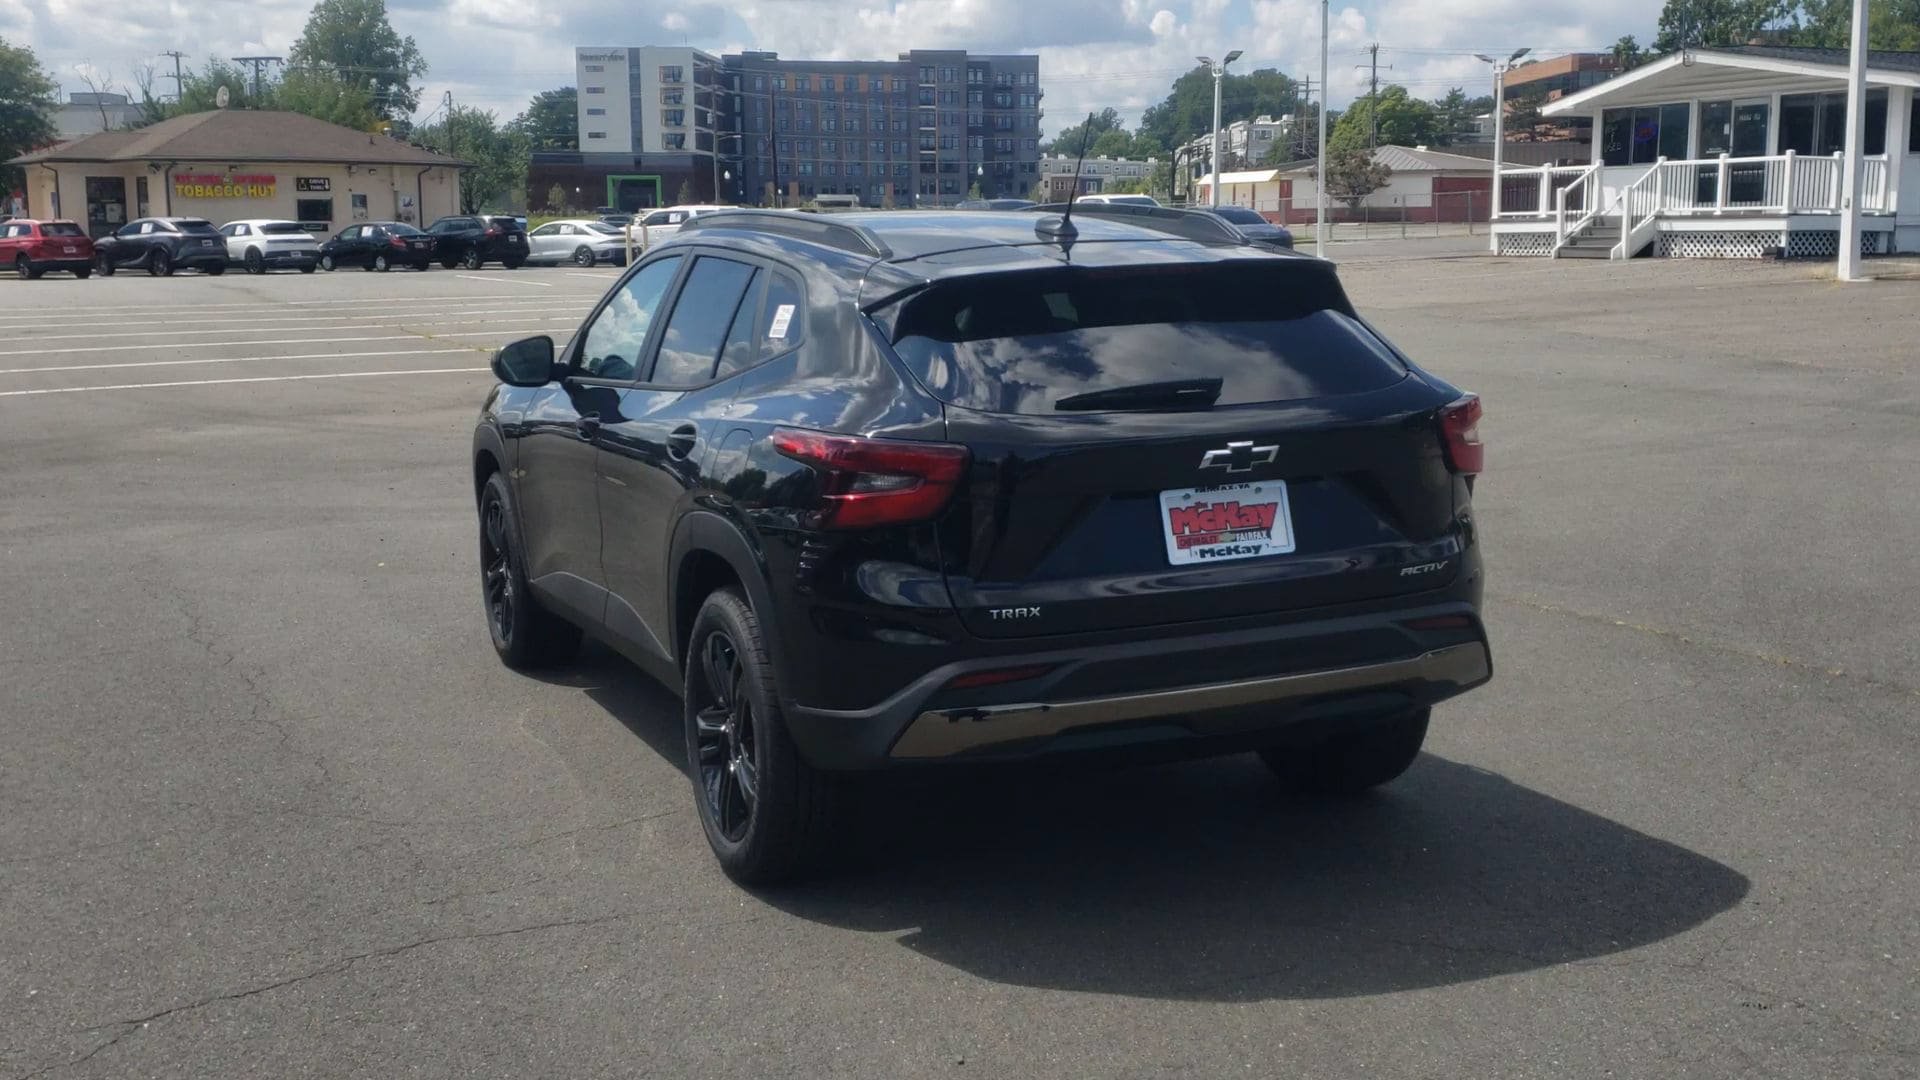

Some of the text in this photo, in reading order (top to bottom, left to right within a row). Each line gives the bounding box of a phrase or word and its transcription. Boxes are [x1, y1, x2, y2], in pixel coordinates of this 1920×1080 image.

[175, 183, 277, 198] TOBACCO HUT
[1169, 501, 1279, 536] McKay
[1236, 530, 1268, 542] FAIRFAX
[1199, 543, 1263, 559] McKay
[1400, 560, 1449, 576] ACTIV
[989, 606, 1041, 620] TRAX
